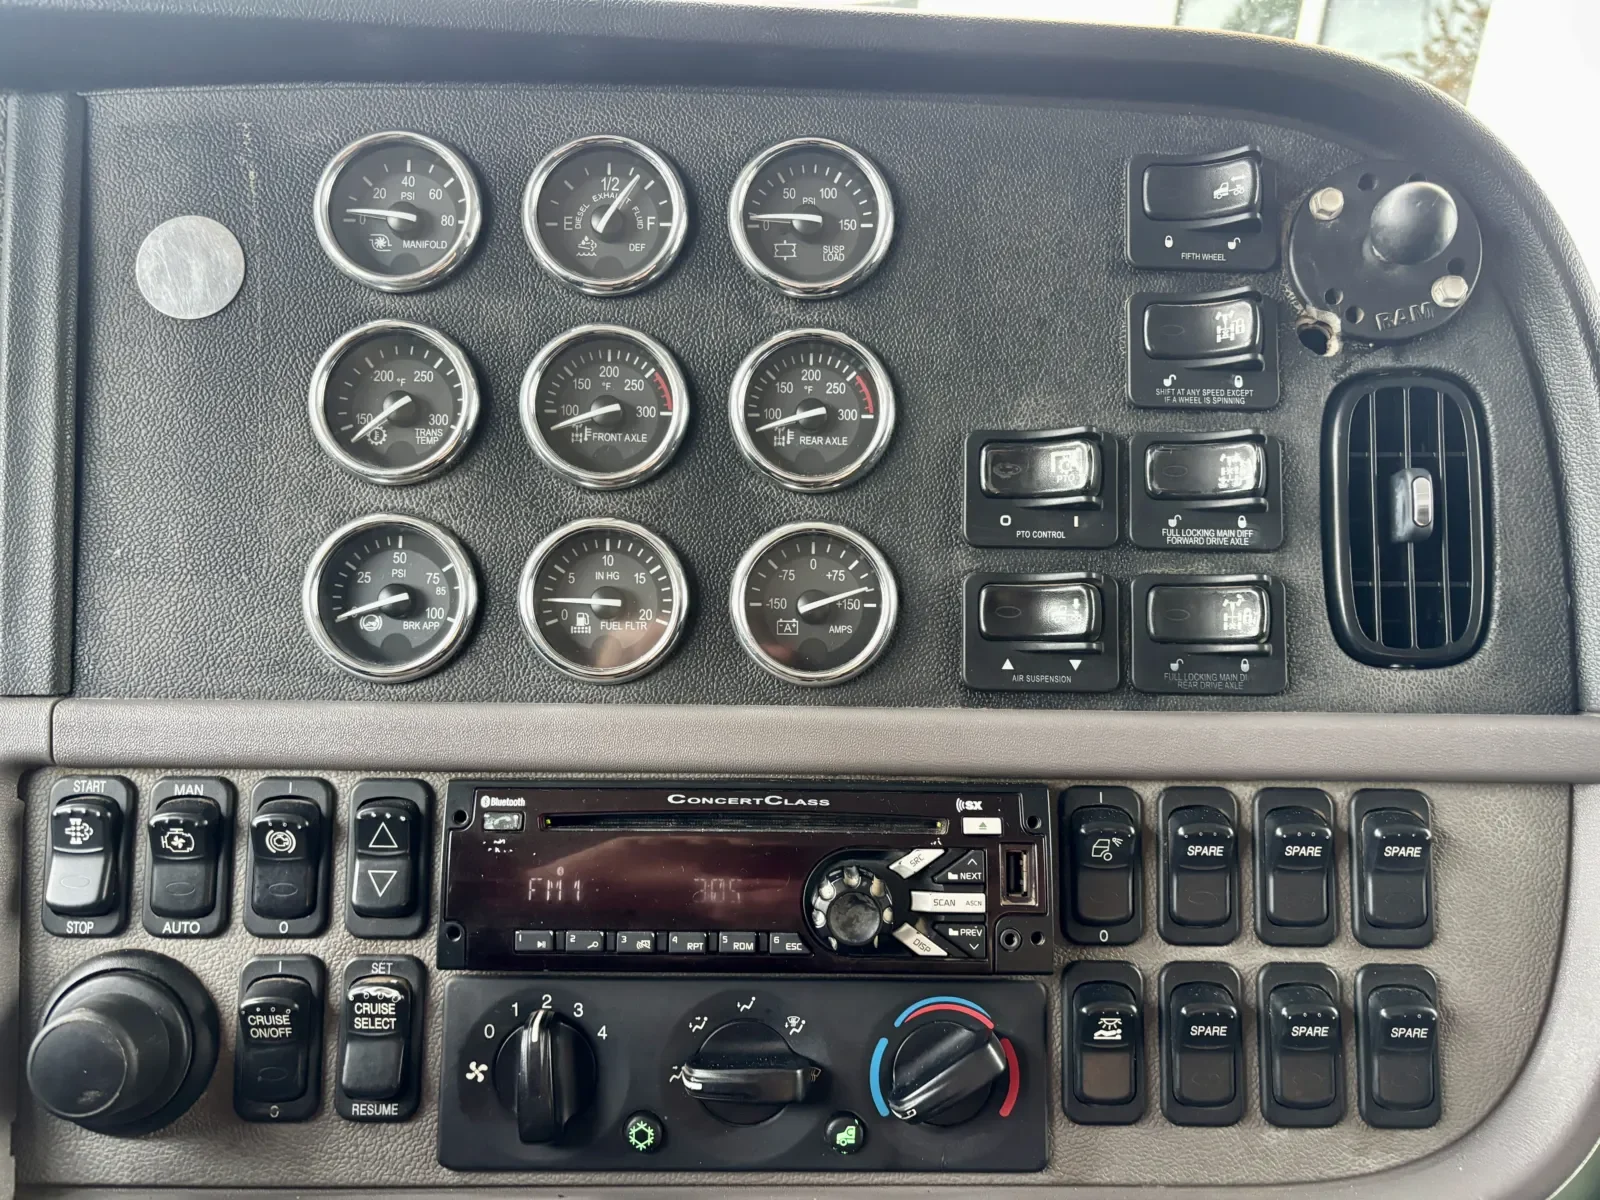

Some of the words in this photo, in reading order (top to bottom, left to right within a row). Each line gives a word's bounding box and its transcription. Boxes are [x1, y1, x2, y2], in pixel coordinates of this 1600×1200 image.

[402, 176, 416, 188] 40
[600, 177, 620, 191] 1/2
[373, 188, 386, 199] 20
[401, 192, 415, 200] PSI
[429, 188, 442, 200] 60
[783, 188, 796, 199] 50
[820, 188, 837, 199] 100
[574, 203, 590, 230] DIESEL
[592, 192, 632, 204] EXHAT
[632, 206, 644, 230] FLUID
[440, 215, 454, 226] 80
[564, 216, 573, 230] E
[647, 217, 656, 230] F
[763, 220, 770, 231] 0
[838, 220, 856, 230] 150
[402, 240, 448, 249] MANIFOLD
[629, 243, 646, 251] DEF
[822, 246, 844, 254] SUSP
[1202, 253, 1226, 261] WHEEL
[1376, 302, 1434, 331] RAM
[374, 370, 394, 382] 200
[414, 371, 434, 382] 250
[600, 366, 620, 378] 200
[801, 370, 822, 381] 200
[572, 378, 591, 390] 150
[624, 380, 644, 392] 250
[776, 382, 794, 394] 150
[826, 382, 846, 394] 250
[561, 405, 579, 416] 100
[636, 406, 656, 418] 300
[764, 408, 782, 420] 100
[838, 409, 858, 421] 300
[356, 414, 373, 425] 150
[428, 414, 448, 426] 300
[415, 428, 443, 437] TRANS
[592, 432, 622, 442] FRONT
[624, 434, 648, 442] AXLE
[800, 436, 824, 446] REAR
[825, 437, 848, 446] AXLE
[1057, 474, 1074, 482] PTO
[1032, 531, 1066, 539] CONTROL
[1162, 529, 1180, 537] FULL
[1182, 529, 1215, 537] LOCKING
[1216, 530, 1235, 538] MAIN
[1237, 530, 1253, 538] DIFF
[1166, 537, 1204, 545] FORWARD
[1206, 537, 1228, 545] DRIVE
[1230, 538, 1249, 546] AXLE
[392, 552, 407, 564] 50
[602, 555, 614, 566] 10
[810, 558, 817, 570] 0
[357, 572, 372, 584] 25
[392, 569, 406, 578] PSI
[426, 572, 440, 584] 75
[568, 574, 576, 584] 5
[596, 572, 604, 580] IN
[606, 572, 620, 580] HG
[634, 573, 646, 584] 15
[778, 570, 796, 581] -75
[826, 570, 846, 582] +75
[436, 587, 446, 596] 85
[766, 598, 787, 610] -150
[836, 599, 860, 610] +150
[426, 607, 444, 620] 100
[561, 609, 568, 620] 0
[638, 609, 652, 621] 20
[403, 622, 420, 630] BRK
[422, 622, 440, 630] APP
[600, 622, 622, 630] FUEL
[625, 622, 648, 630] FLTR
[828, 626, 852, 634] AMPS
[1026, 674, 1072, 682] SUSPENSION
[1164, 673, 1182, 681] FULL
[1184, 673, 1218, 681] LOCKING
[1219, 674, 1238, 682] MAIN
[74, 780, 106, 792] START
[174, 784, 204, 796] MAN
[491, 797, 526, 806] Bluetooth
[1187, 846, 1224, 856] SPARE
[1284, 846, 1322, 856] SPARE
[1384, 846, 1422, 858] SPARE
[910, 854, 924, 868] SRC
[934, 898, 956, 906] SCAN
[66, 921, 94, 934] STOP
[162, 922, 200, 934] AUTO
[960, 928, 982, 936] PREV
[913, 938, 931, 952] DISP
[371, 962, 393, 974] SET
[542, 994, 552, 1008] 2
[354, 1003, 396, 1014] CRUISE
[512, 1002, 518, 1016] 1
[574, 1003, 584, 1017] 3
[248, 1014, 290, 1026] CRUISE
[354, 1018, 396, 1030] SELECT
[250, 1028, 292, 1038] ON/OFF
[484, 1024, 495, 1038] 0
[598, 1026, 608, 1040] 4
[1190, 1026, 1228, 1036] SPARE
[1291, 1026, 1329, 1036] SPARE
[1390, 1028, 1428, 1038] SPARE
[352, 1104, 398, 1116] RESUME
